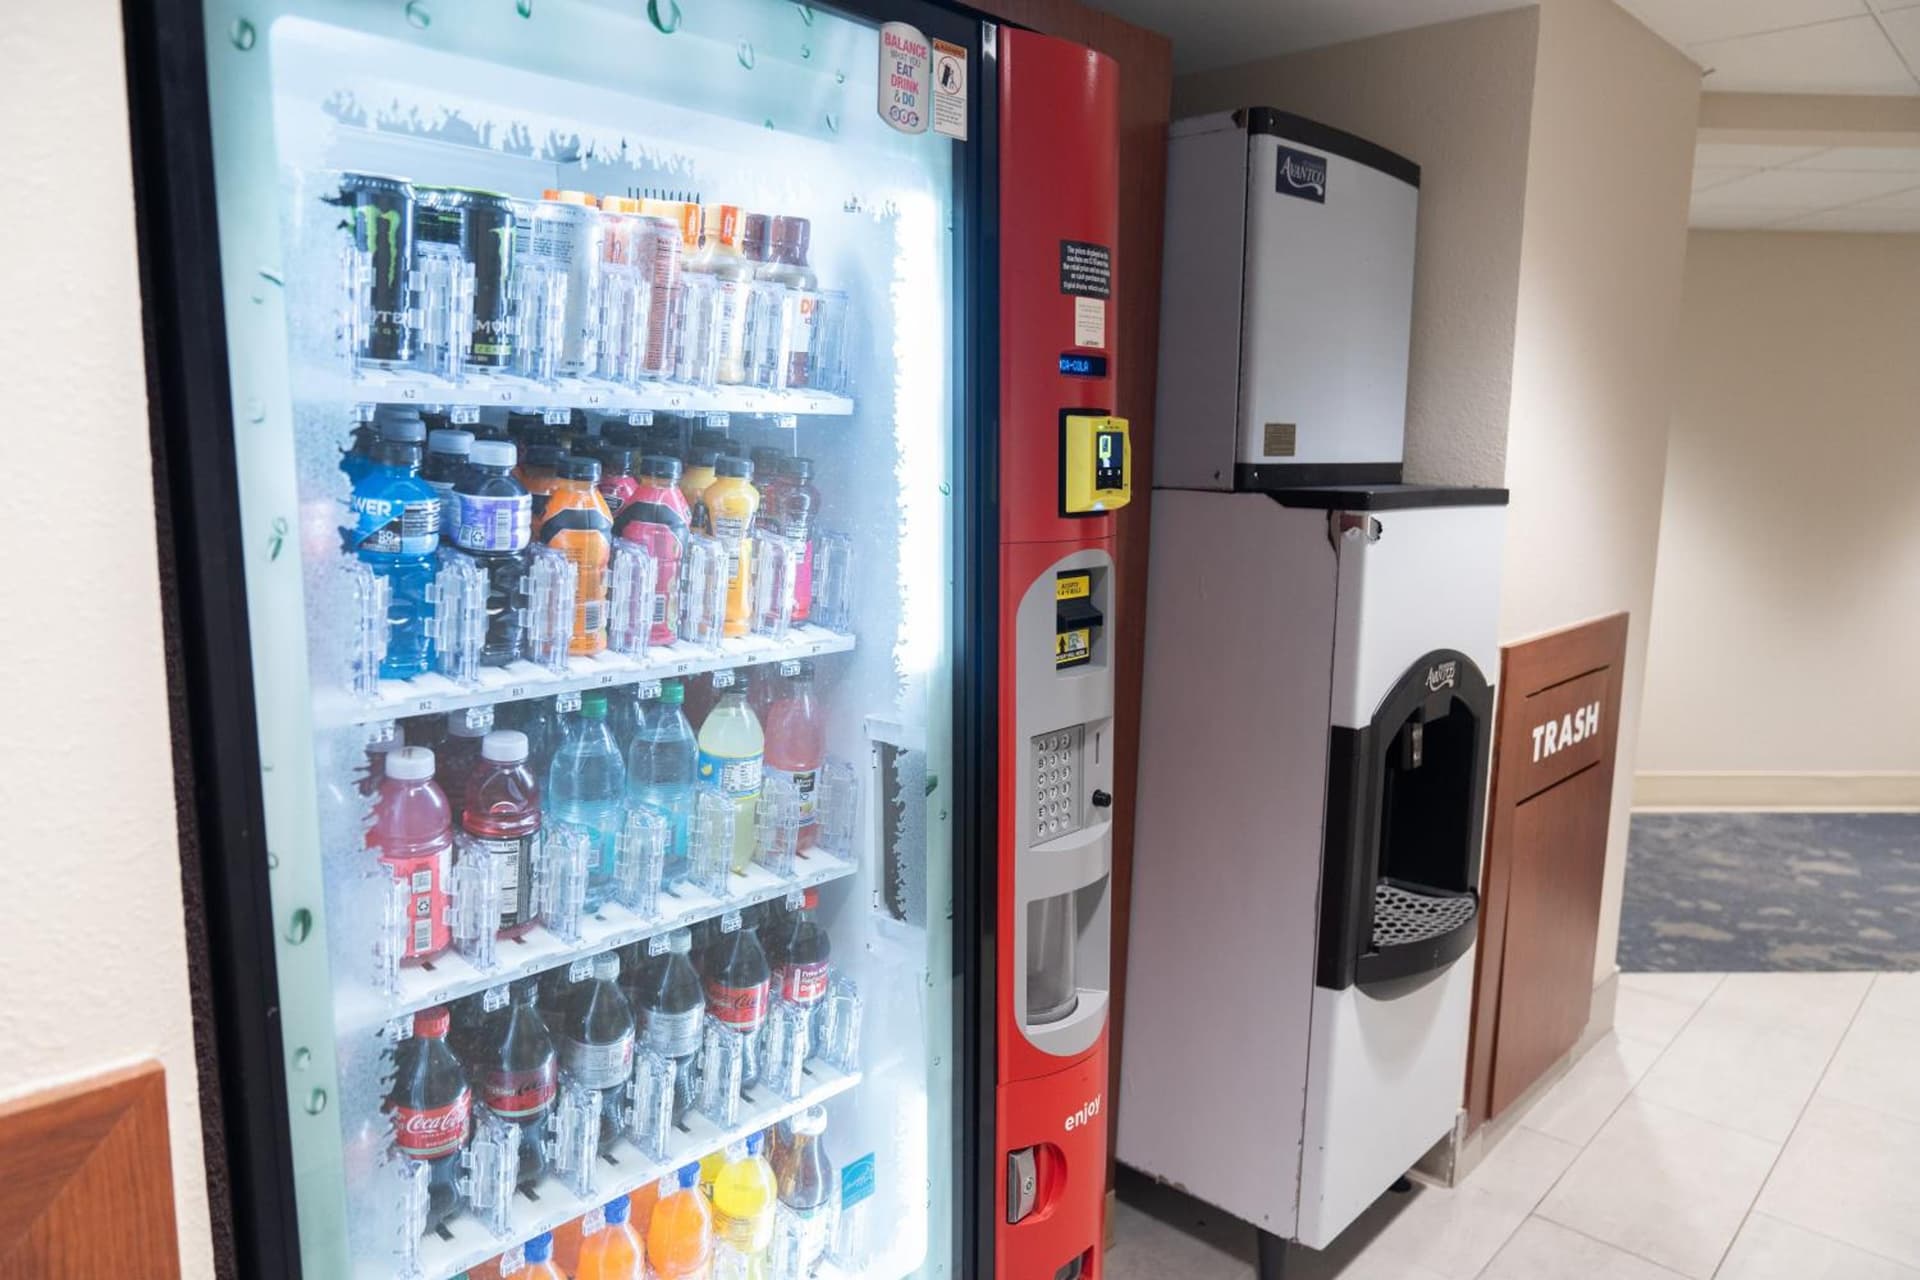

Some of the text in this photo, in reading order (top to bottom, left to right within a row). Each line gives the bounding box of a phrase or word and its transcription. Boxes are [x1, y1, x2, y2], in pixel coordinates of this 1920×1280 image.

[884, 31, 927, 60] BALANCE
[896, 61, 914, 78] EAT
[891, 73, 919, 95] DRINK
[902, 93, 915, 108] DO
[1532, 701, 1600, 763] TRASH
[1064, 1093, 1102, 1131] enjoy
